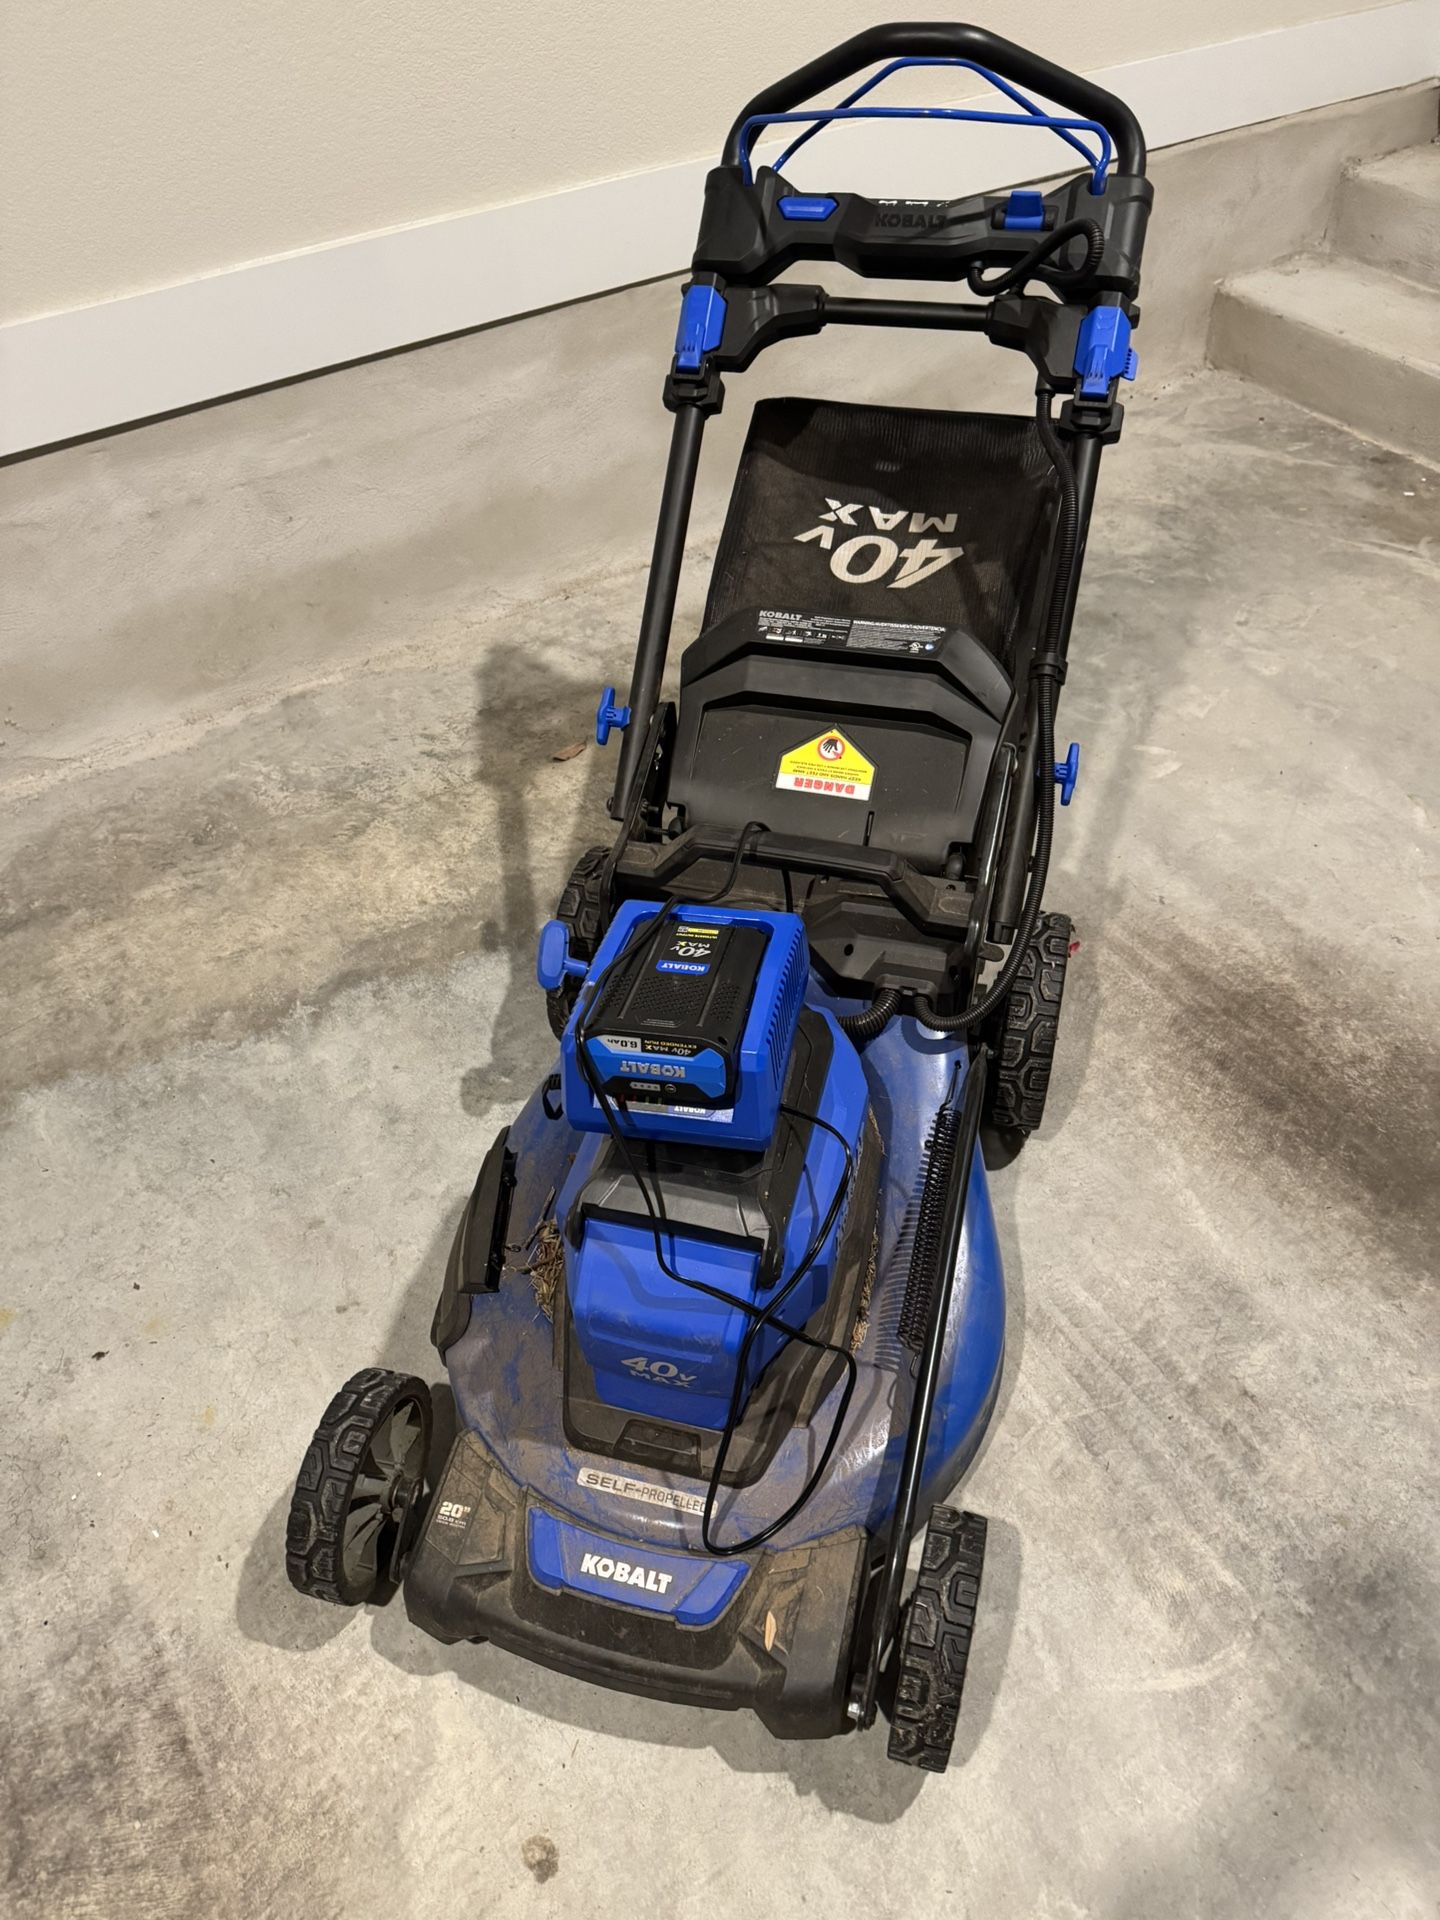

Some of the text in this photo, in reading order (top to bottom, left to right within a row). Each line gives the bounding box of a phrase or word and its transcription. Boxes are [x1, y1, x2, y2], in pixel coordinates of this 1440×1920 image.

[874, 213, 947, 230] KOBALT
[818, 497, 958, 533] MAX
[758, 609, 803, 622] KOBALT
[793, 777, 856, 795] DANGER
[660, 962, 706, 972] KOBALT
[644, 1044, 669, 1052] MAX
[659, 1041, 698, 1049] EXTENDED
[619, 1060, 686, 1079] KOBALT
[673, 1105, 707, 1114] KOBALT
[629, 1369, 691, 1388] MAX
[580, 1552, 672, 1595] KOBALT
